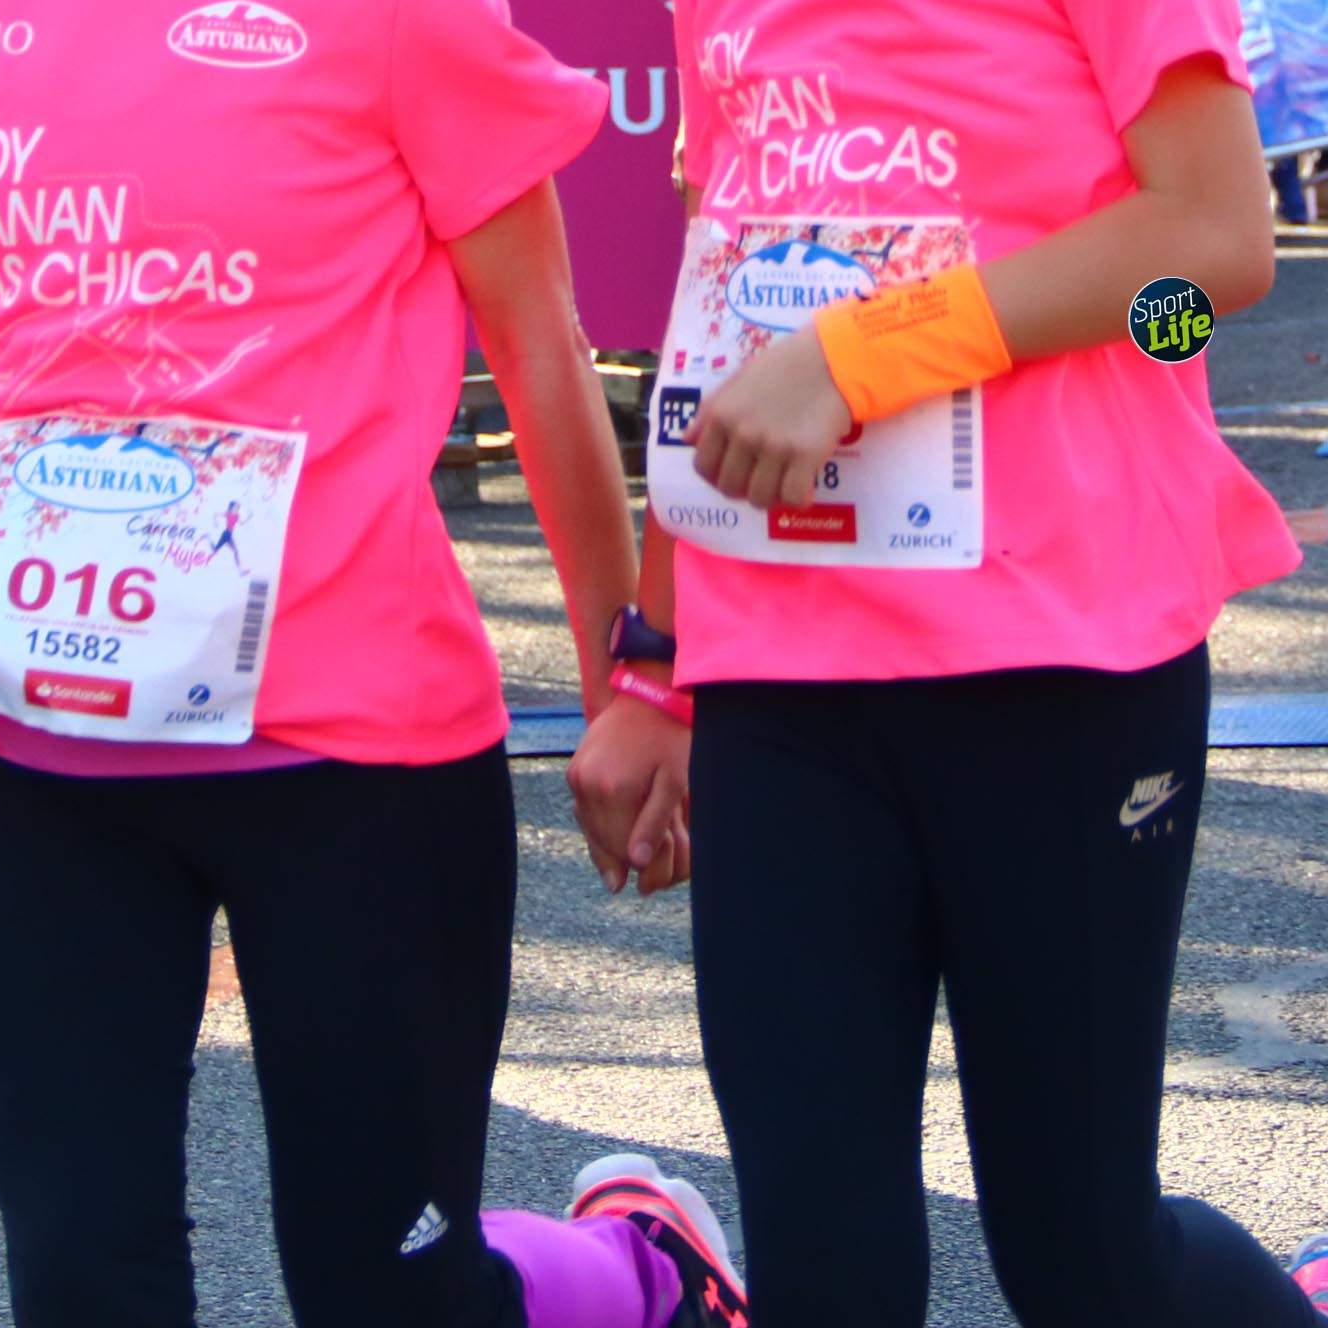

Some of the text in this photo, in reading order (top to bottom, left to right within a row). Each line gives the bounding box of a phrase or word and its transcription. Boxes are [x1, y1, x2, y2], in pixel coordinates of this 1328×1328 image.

[176, 22, 294, 55] ASTURIANA
[760, 125, 959, 199] CHICAS
[30, 247, 258, 308] CHICAS
[27, 454, 179, 496] ASTURIANA
[126, 514, 197, 541] Carrera
[668, 504, 738, 531] OYSHO
[786, 516, 845, 531] Santander
[160, 538, 213, 575] Mujer
[889, 532, 953, 549] ZURICH
[8, 557, 159, 623] 016
[26, 628, 121, 665] 15582
[53, 684, 118, 706] Santander
[164, 710, 225, 724] ZURICH
[1130, 771, 1174, 805] NIKE
[399, 1218, 449, 1254] adidas
